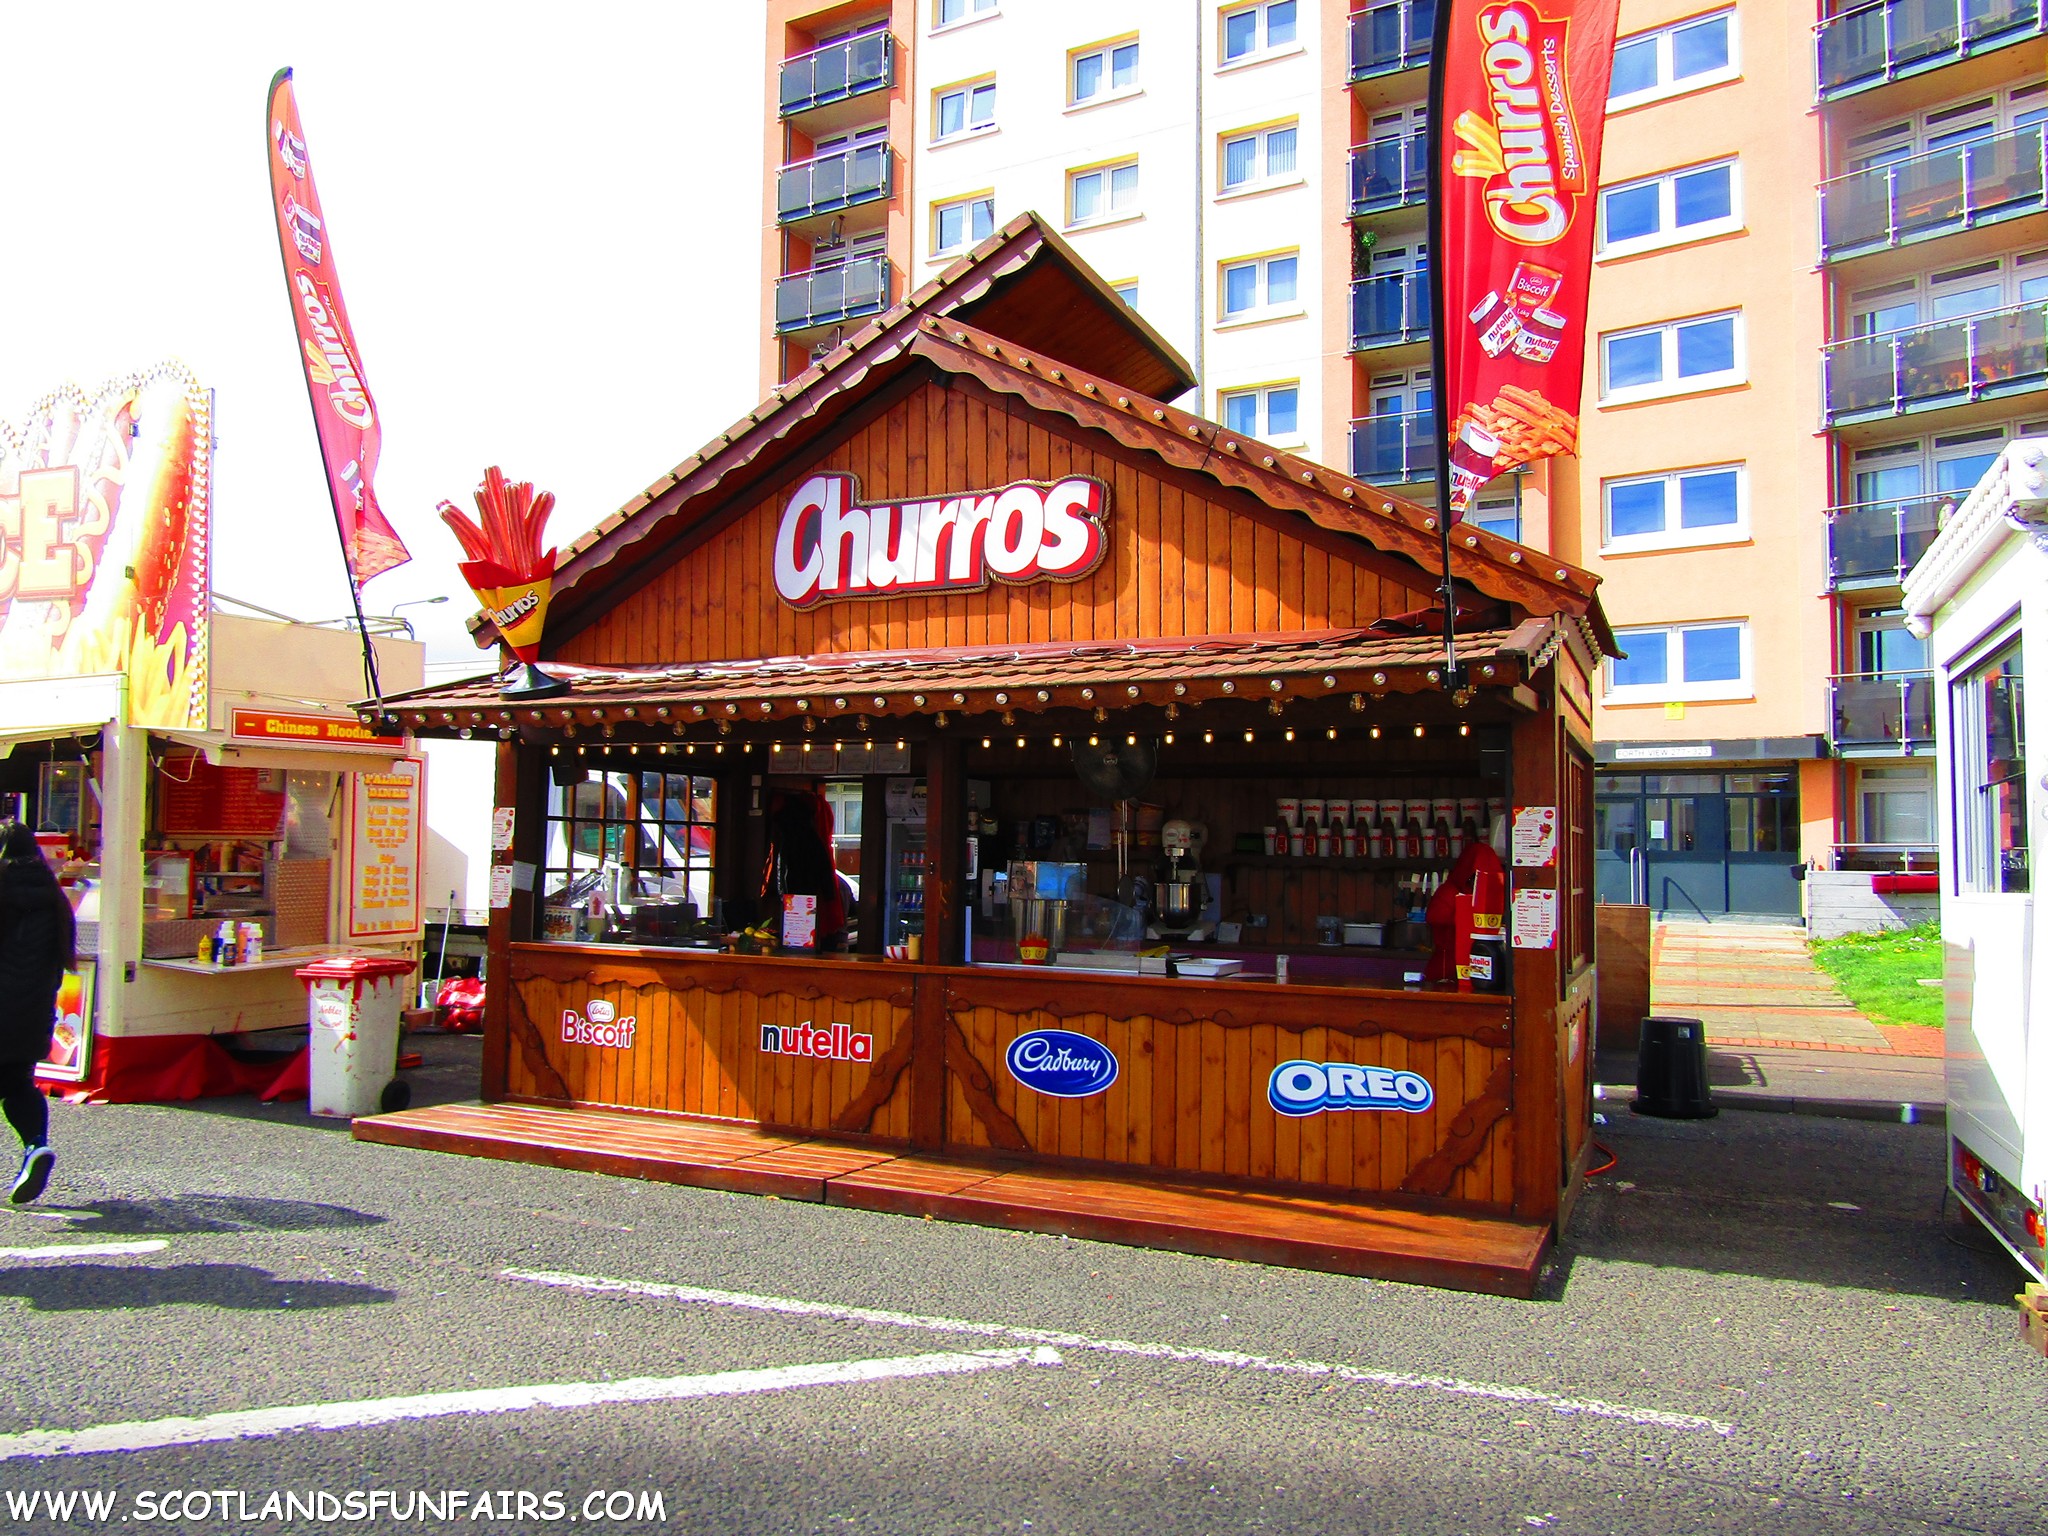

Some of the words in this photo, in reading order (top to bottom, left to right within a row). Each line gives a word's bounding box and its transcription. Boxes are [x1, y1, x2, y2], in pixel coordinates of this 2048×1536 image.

[1537, 38, 1565, 114] Desserts
[1482, 9, 1566, 242] Churros
[1554, 116, 1577, 181] Spanish
[1517, 278, 1550, 297] Biscoff
[1487, 311, 1515, 342] nutella
[1525, 335, 1557, 350] nutella
[295, 274, 373, 428] Churros
[773, 475, 1100, 604] Churros
[487, 590, 540, 628] Churros
[265, 719, 319, 736] Chinese
[364, 773, 413, 787] PALACE
[562, 1009, 636, 1049] Biscoff
[591, 1003, 612, 1019] Lotus
[760, 1021, 873, 1063] nutella
[1014, 1036, 1102, 1080] Cadbury
[1275, 1064, 1428, 1103] OREO
